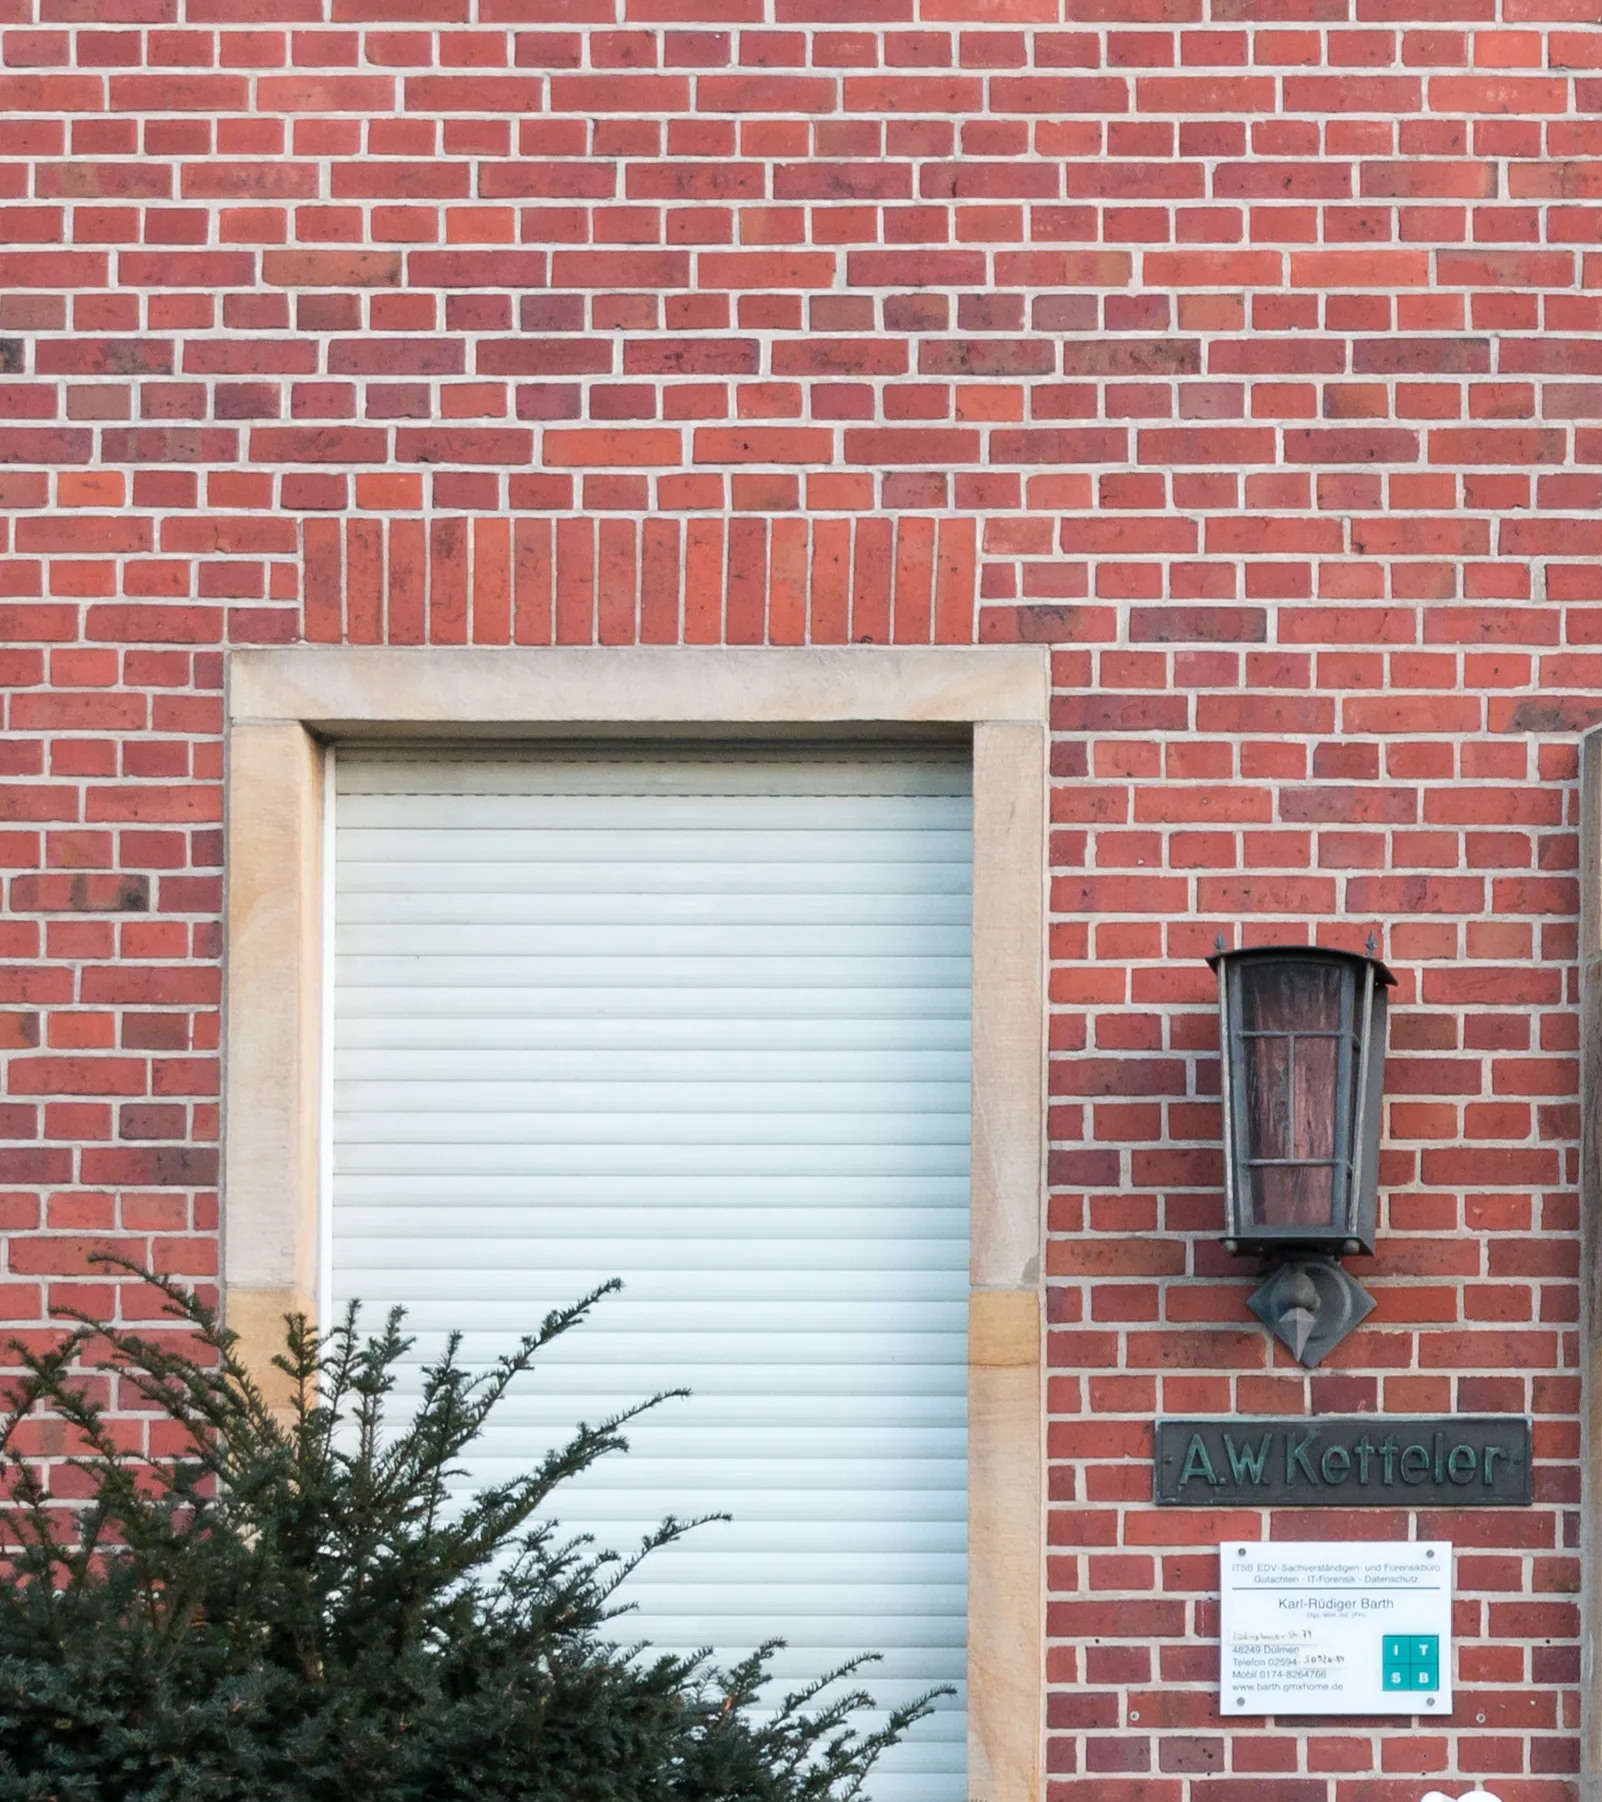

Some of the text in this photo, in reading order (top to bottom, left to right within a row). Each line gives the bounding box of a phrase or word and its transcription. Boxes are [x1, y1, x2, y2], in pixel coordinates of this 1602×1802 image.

[1284, 1432, 1505, 1486] Ketteler
[1365, 1563, 1381, 1572] und
[1384, 1563, 1441, 1572] Forensikbüro
[1254, 1575, 1299, 1584] Gutachten
[1307, 1574, 1356, 1583] IT-Forensik
[1364, 1574, 1418, 1583] Datenschutz
[1278, 1597, 1394, 1612] Karl-Rüdiger Barth
[1231, 1645, 1299, 1654] 48249 Dülmen
[1232, 1658, 1266, 1667] Telefon
[1231, 1670, 1257, 1679] Mobil
